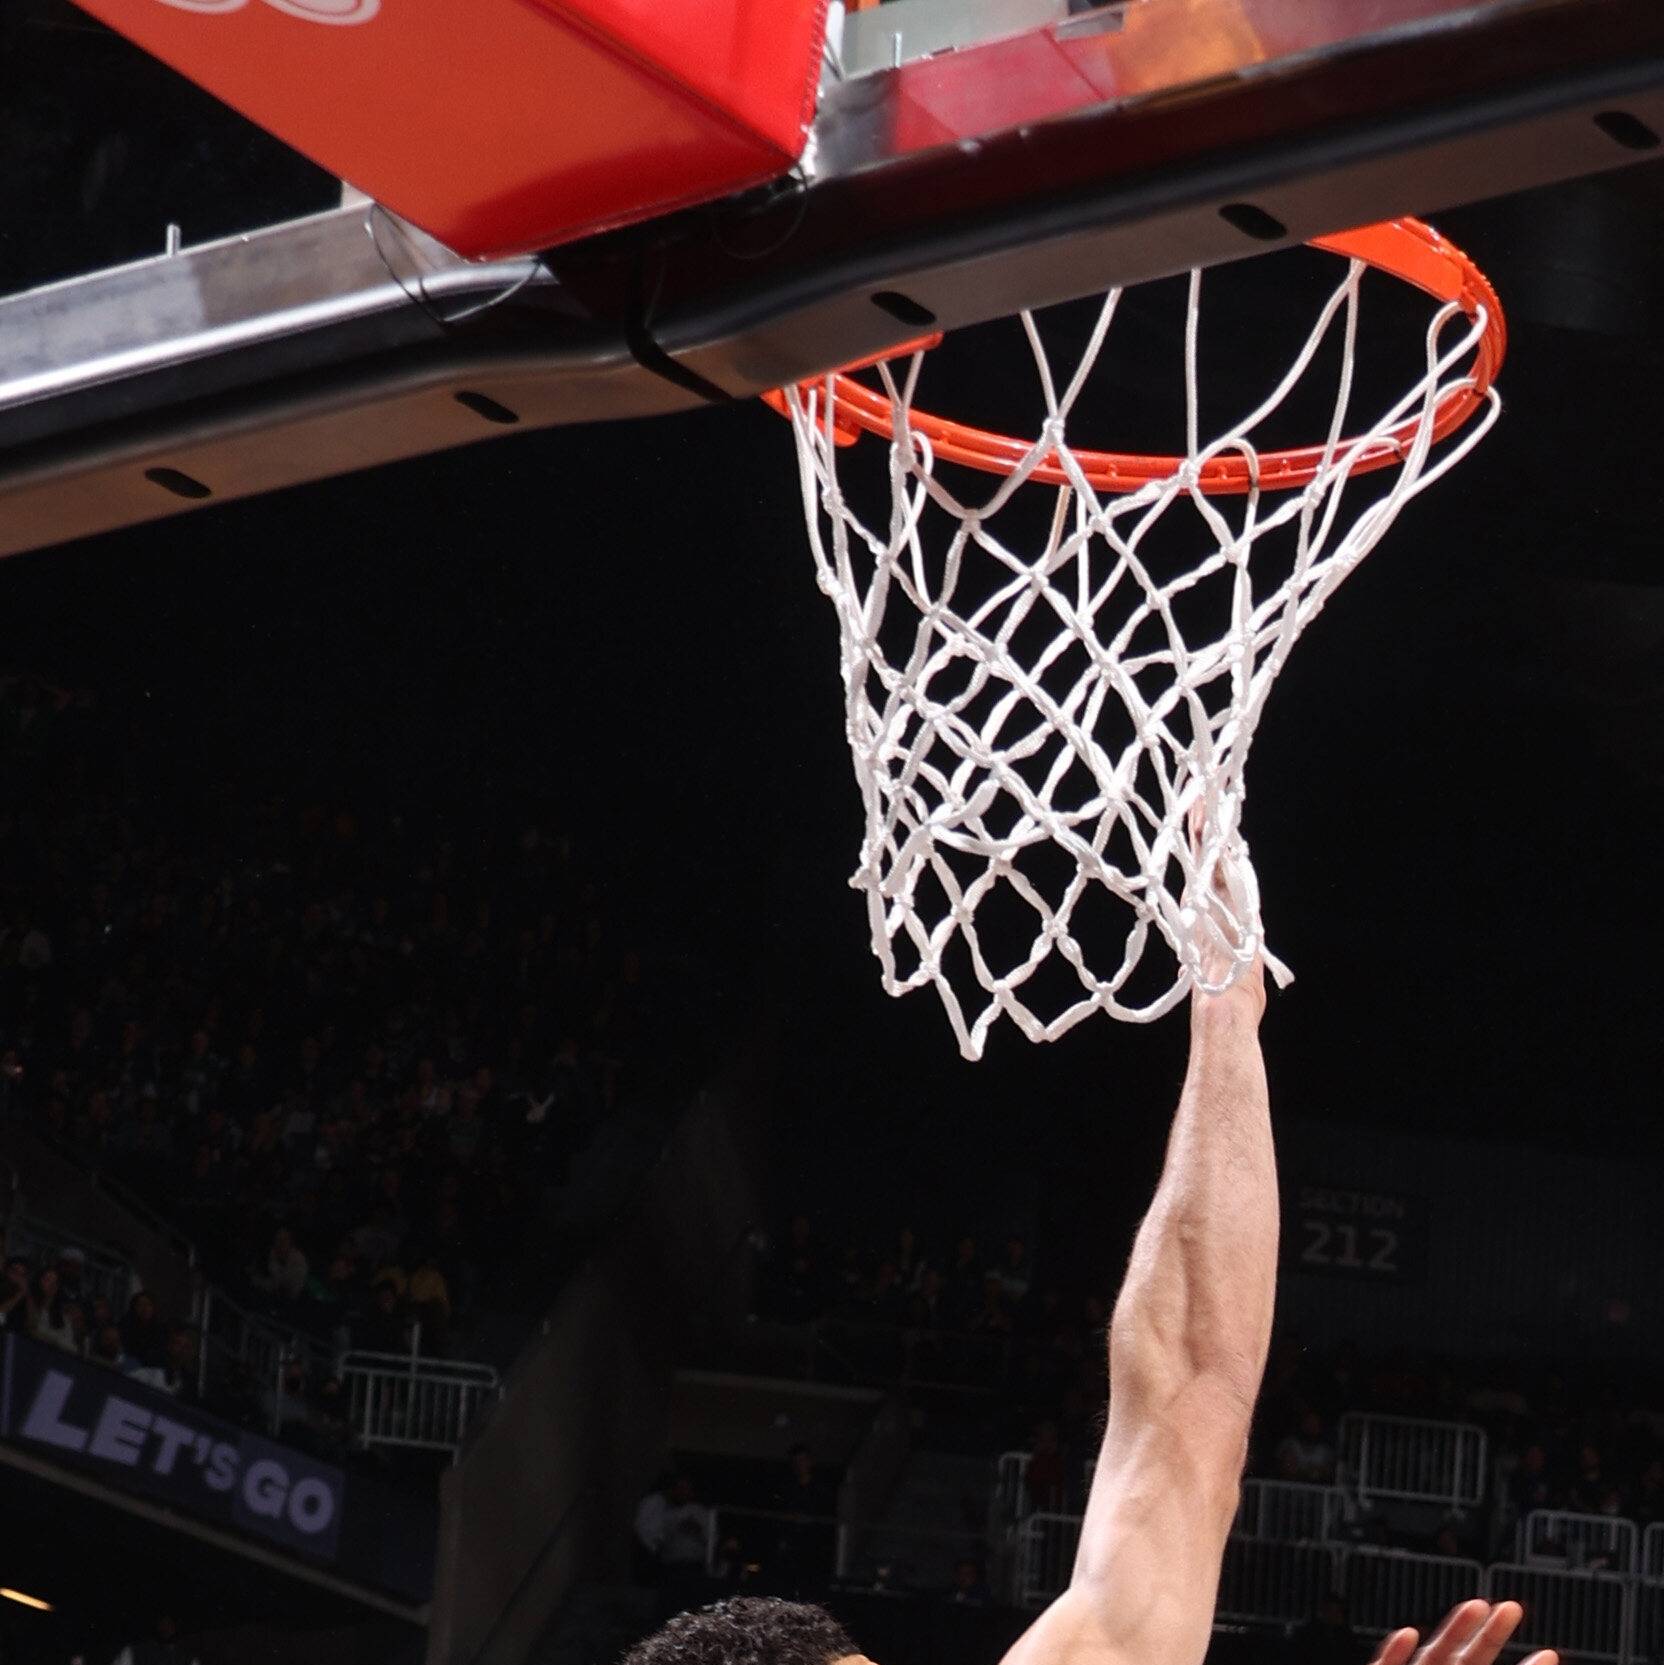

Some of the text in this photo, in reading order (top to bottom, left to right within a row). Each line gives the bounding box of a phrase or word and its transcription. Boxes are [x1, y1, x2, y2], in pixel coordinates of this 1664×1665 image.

[1301, 1221, 1398, 1271] 212
[20, 1369, 336, 1534] LET'S GO
